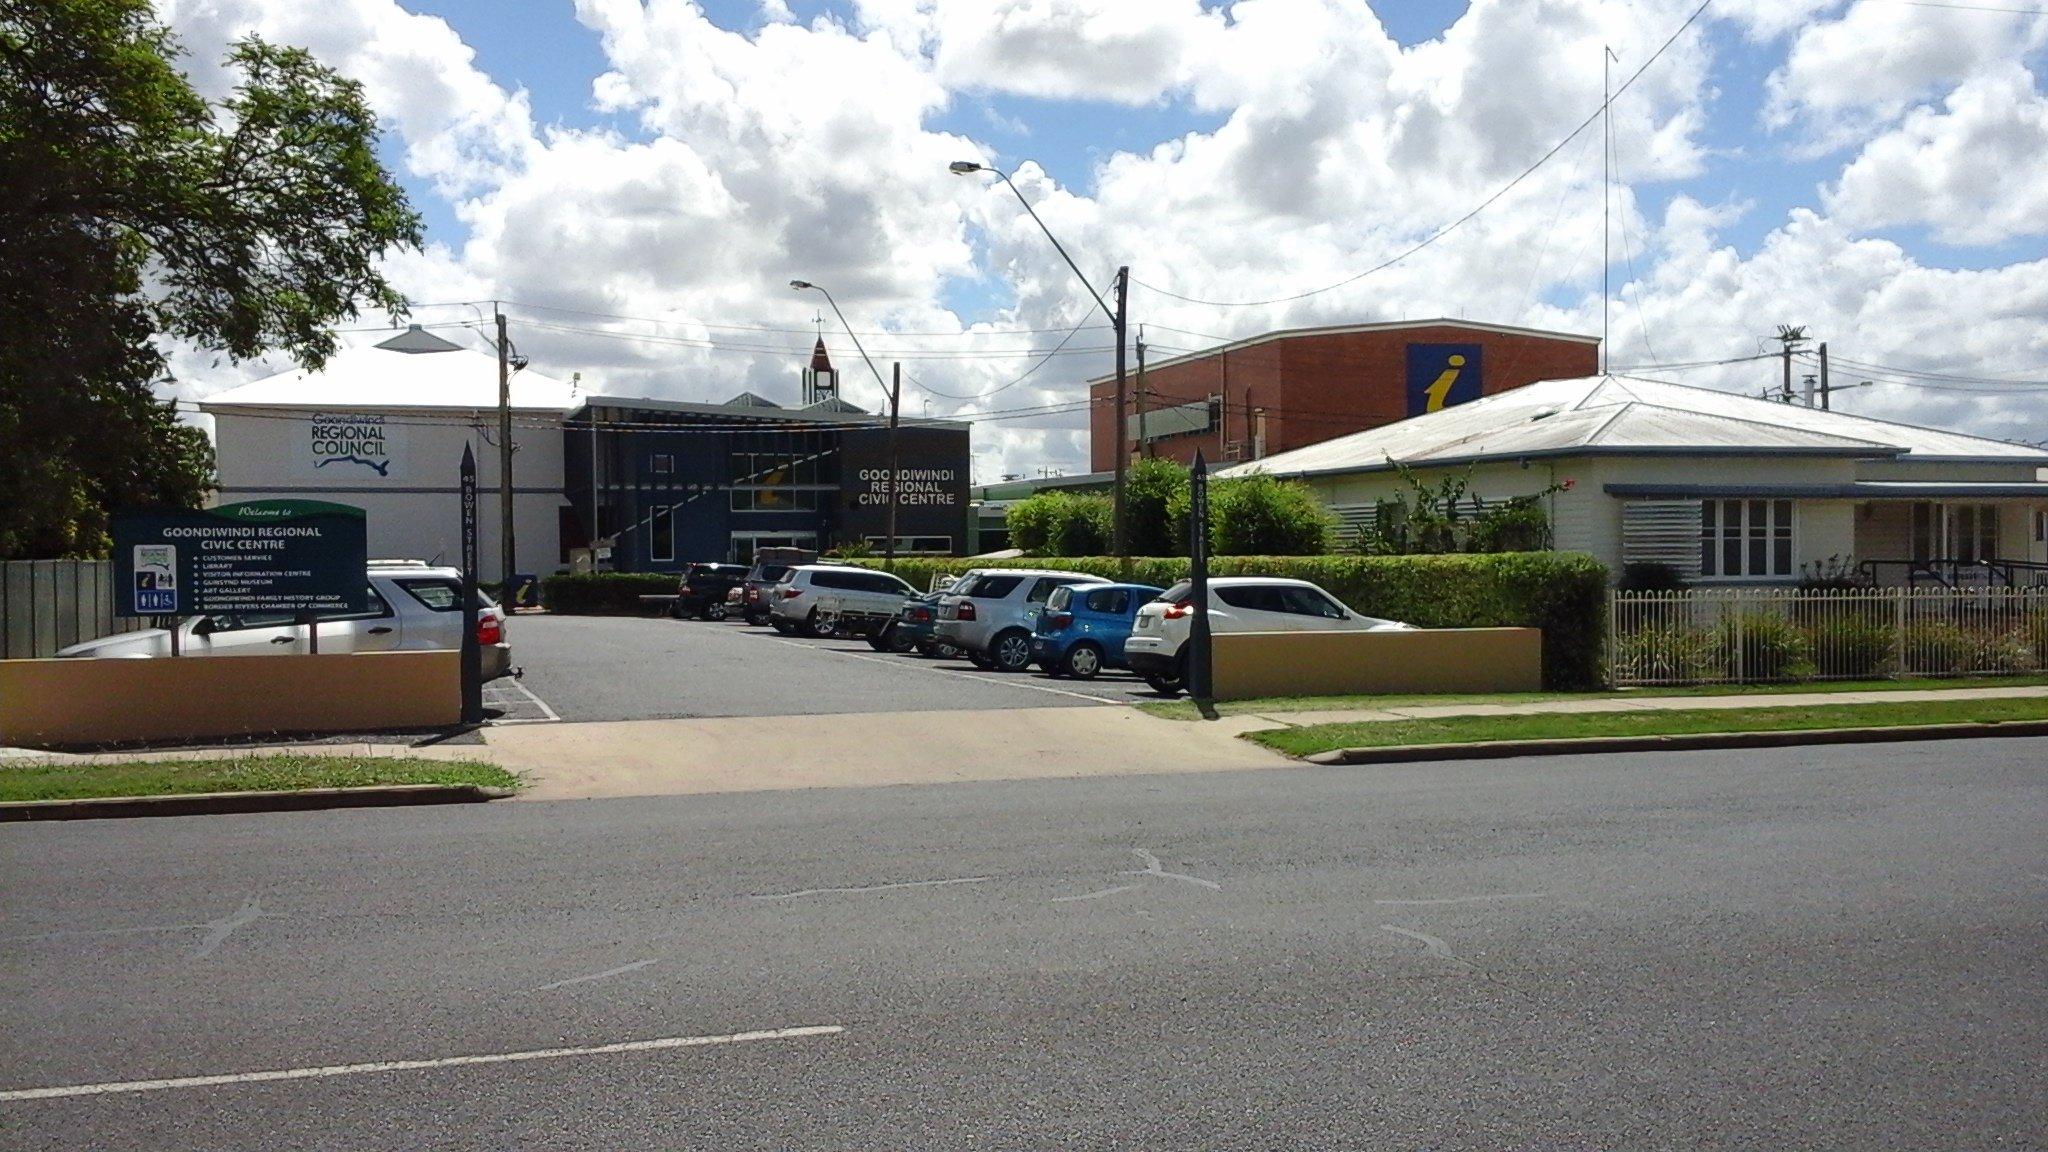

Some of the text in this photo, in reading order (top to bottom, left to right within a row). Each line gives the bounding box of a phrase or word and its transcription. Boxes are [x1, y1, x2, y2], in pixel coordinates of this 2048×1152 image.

[312, 426, 385, 440] REGIONAL
[312, 440, 385, 455] COUNCIL
[899, 493, 955, 505] CENTRE
[463, 485, 474, 525] BOWEN
[238, 506, 292, 517] Welcome to
[162, 527, 322, 538] GOONDIWINDI REGIONAL
[201, 539, 285, 550] CIVIC CENTRE
[202, 554, 242, 562] CUSTOMER
[202, 603, 234, 611] BORDER
